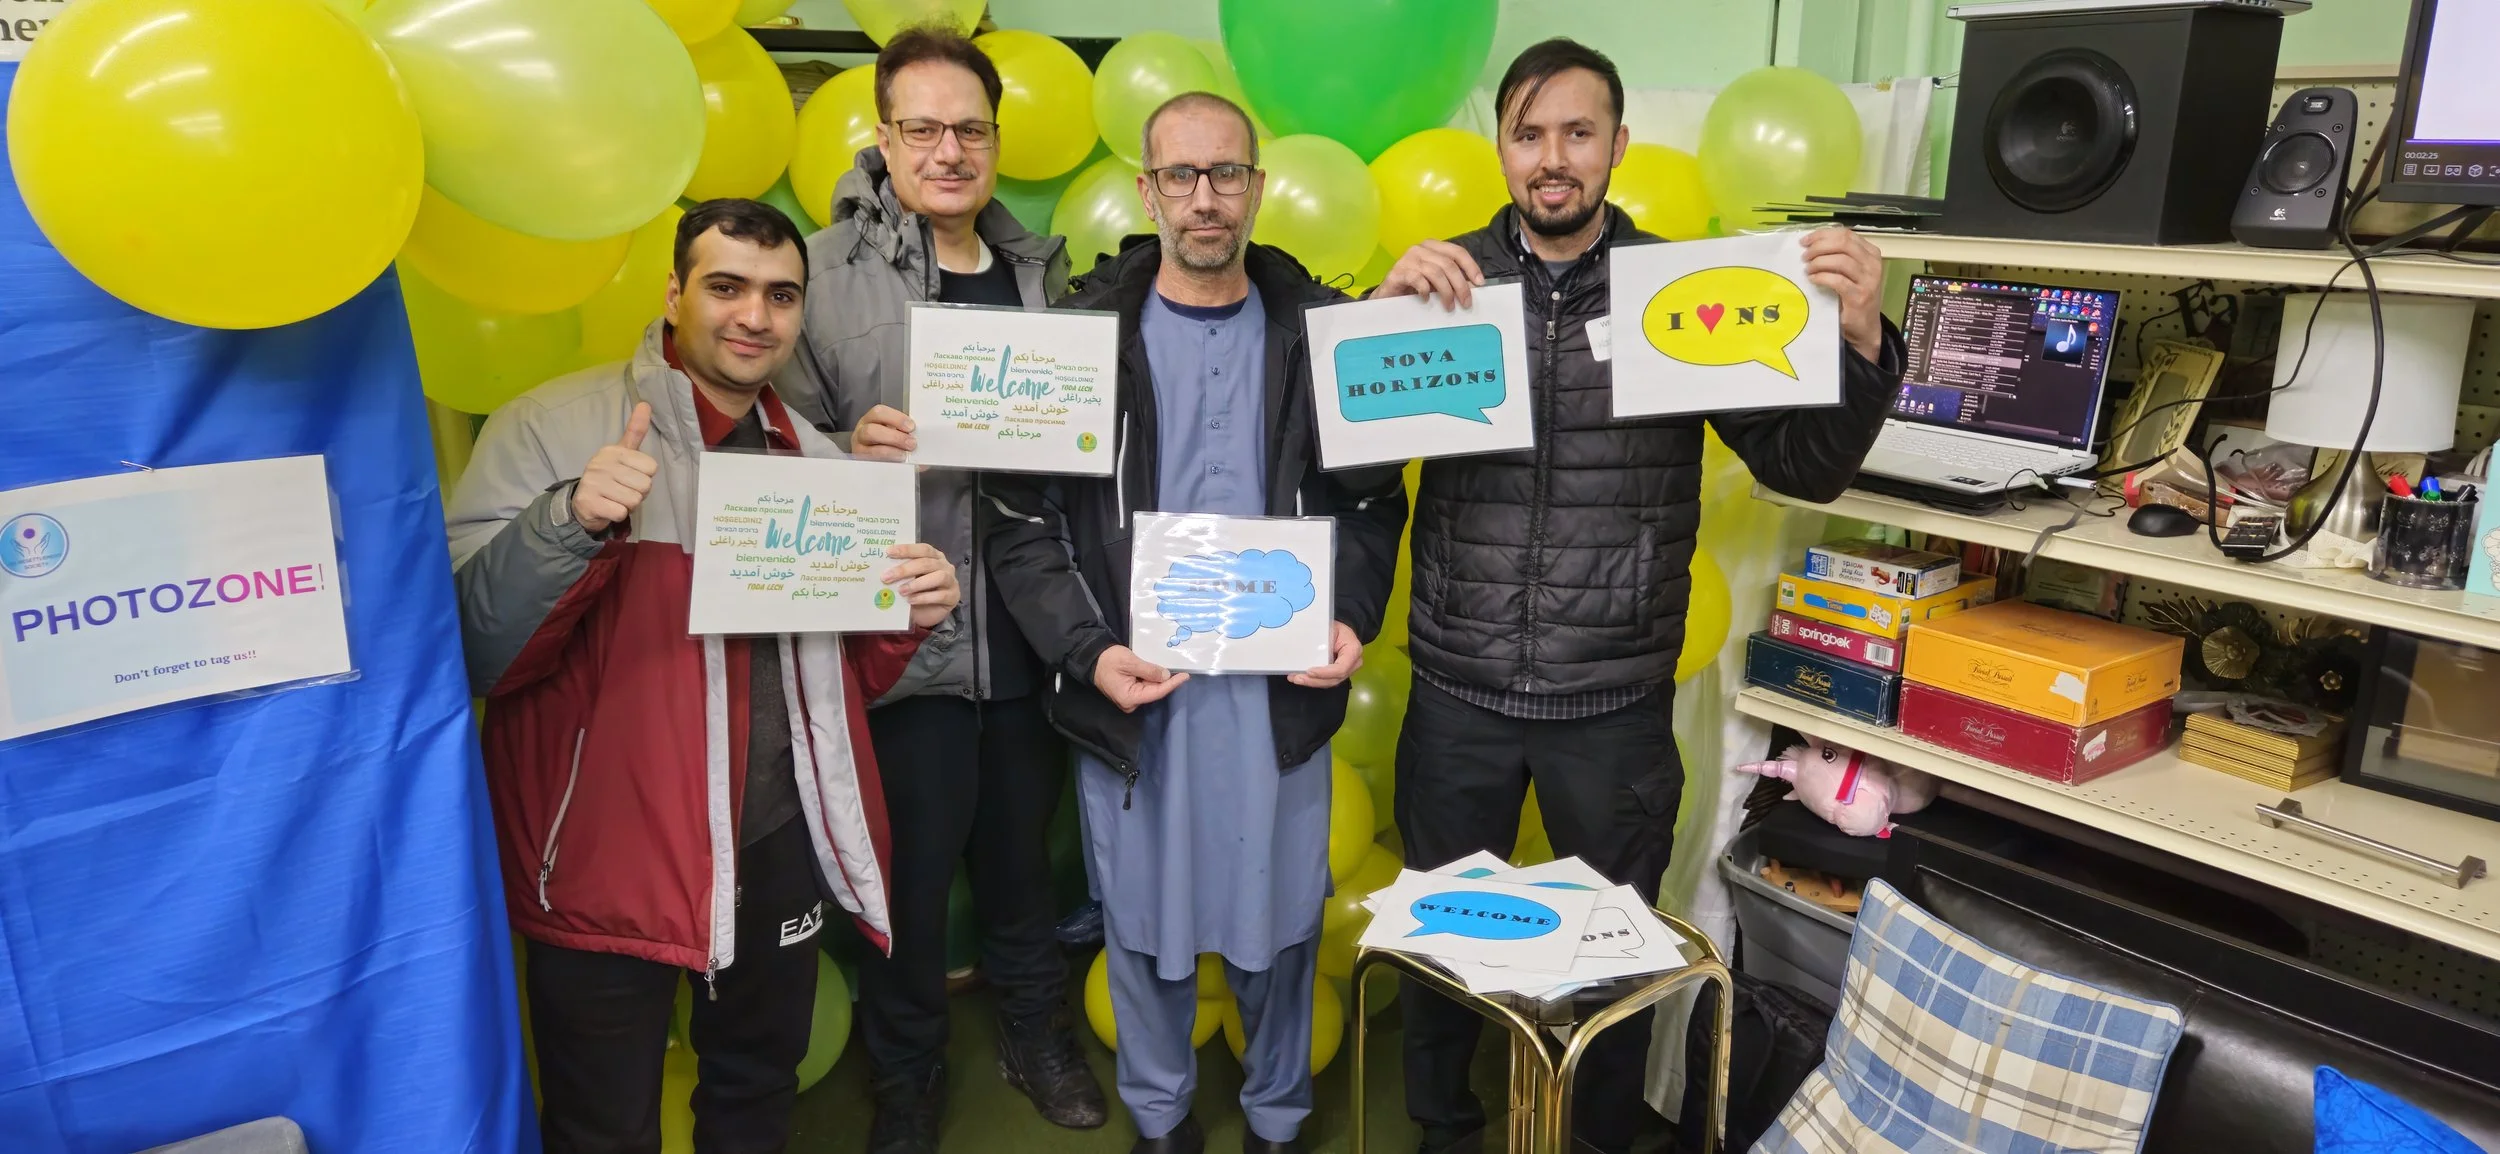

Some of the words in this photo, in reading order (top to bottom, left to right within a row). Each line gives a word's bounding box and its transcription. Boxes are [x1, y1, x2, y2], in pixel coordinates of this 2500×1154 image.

[1666, 311, 1686, 332] I
[1736, 304, 1781, 326] NS
[1010, 366, 1053, 375] bienvenido
[1380, 348, 1457, 371] NOVA
[1344, 368, 1497, 399] HORIZONS
[945, 395, 999, 406] bienvenido
[809, 519, 855, 528] bienvenido
[736, 553, 796, 564] bienvenido
[12, 562, 325, 643] PHOTOZONE!
[1781, 618, 1791, 635] 500
[1798, 626, 1850, 649] springbok
[153, 661, 191, 677] forget
[194, 657, 208, 668] to
[210, 653, 231, 667] tag
[233, 649, 257, 661] us!!
[1417, 901, 1552, 928] WELCOME
